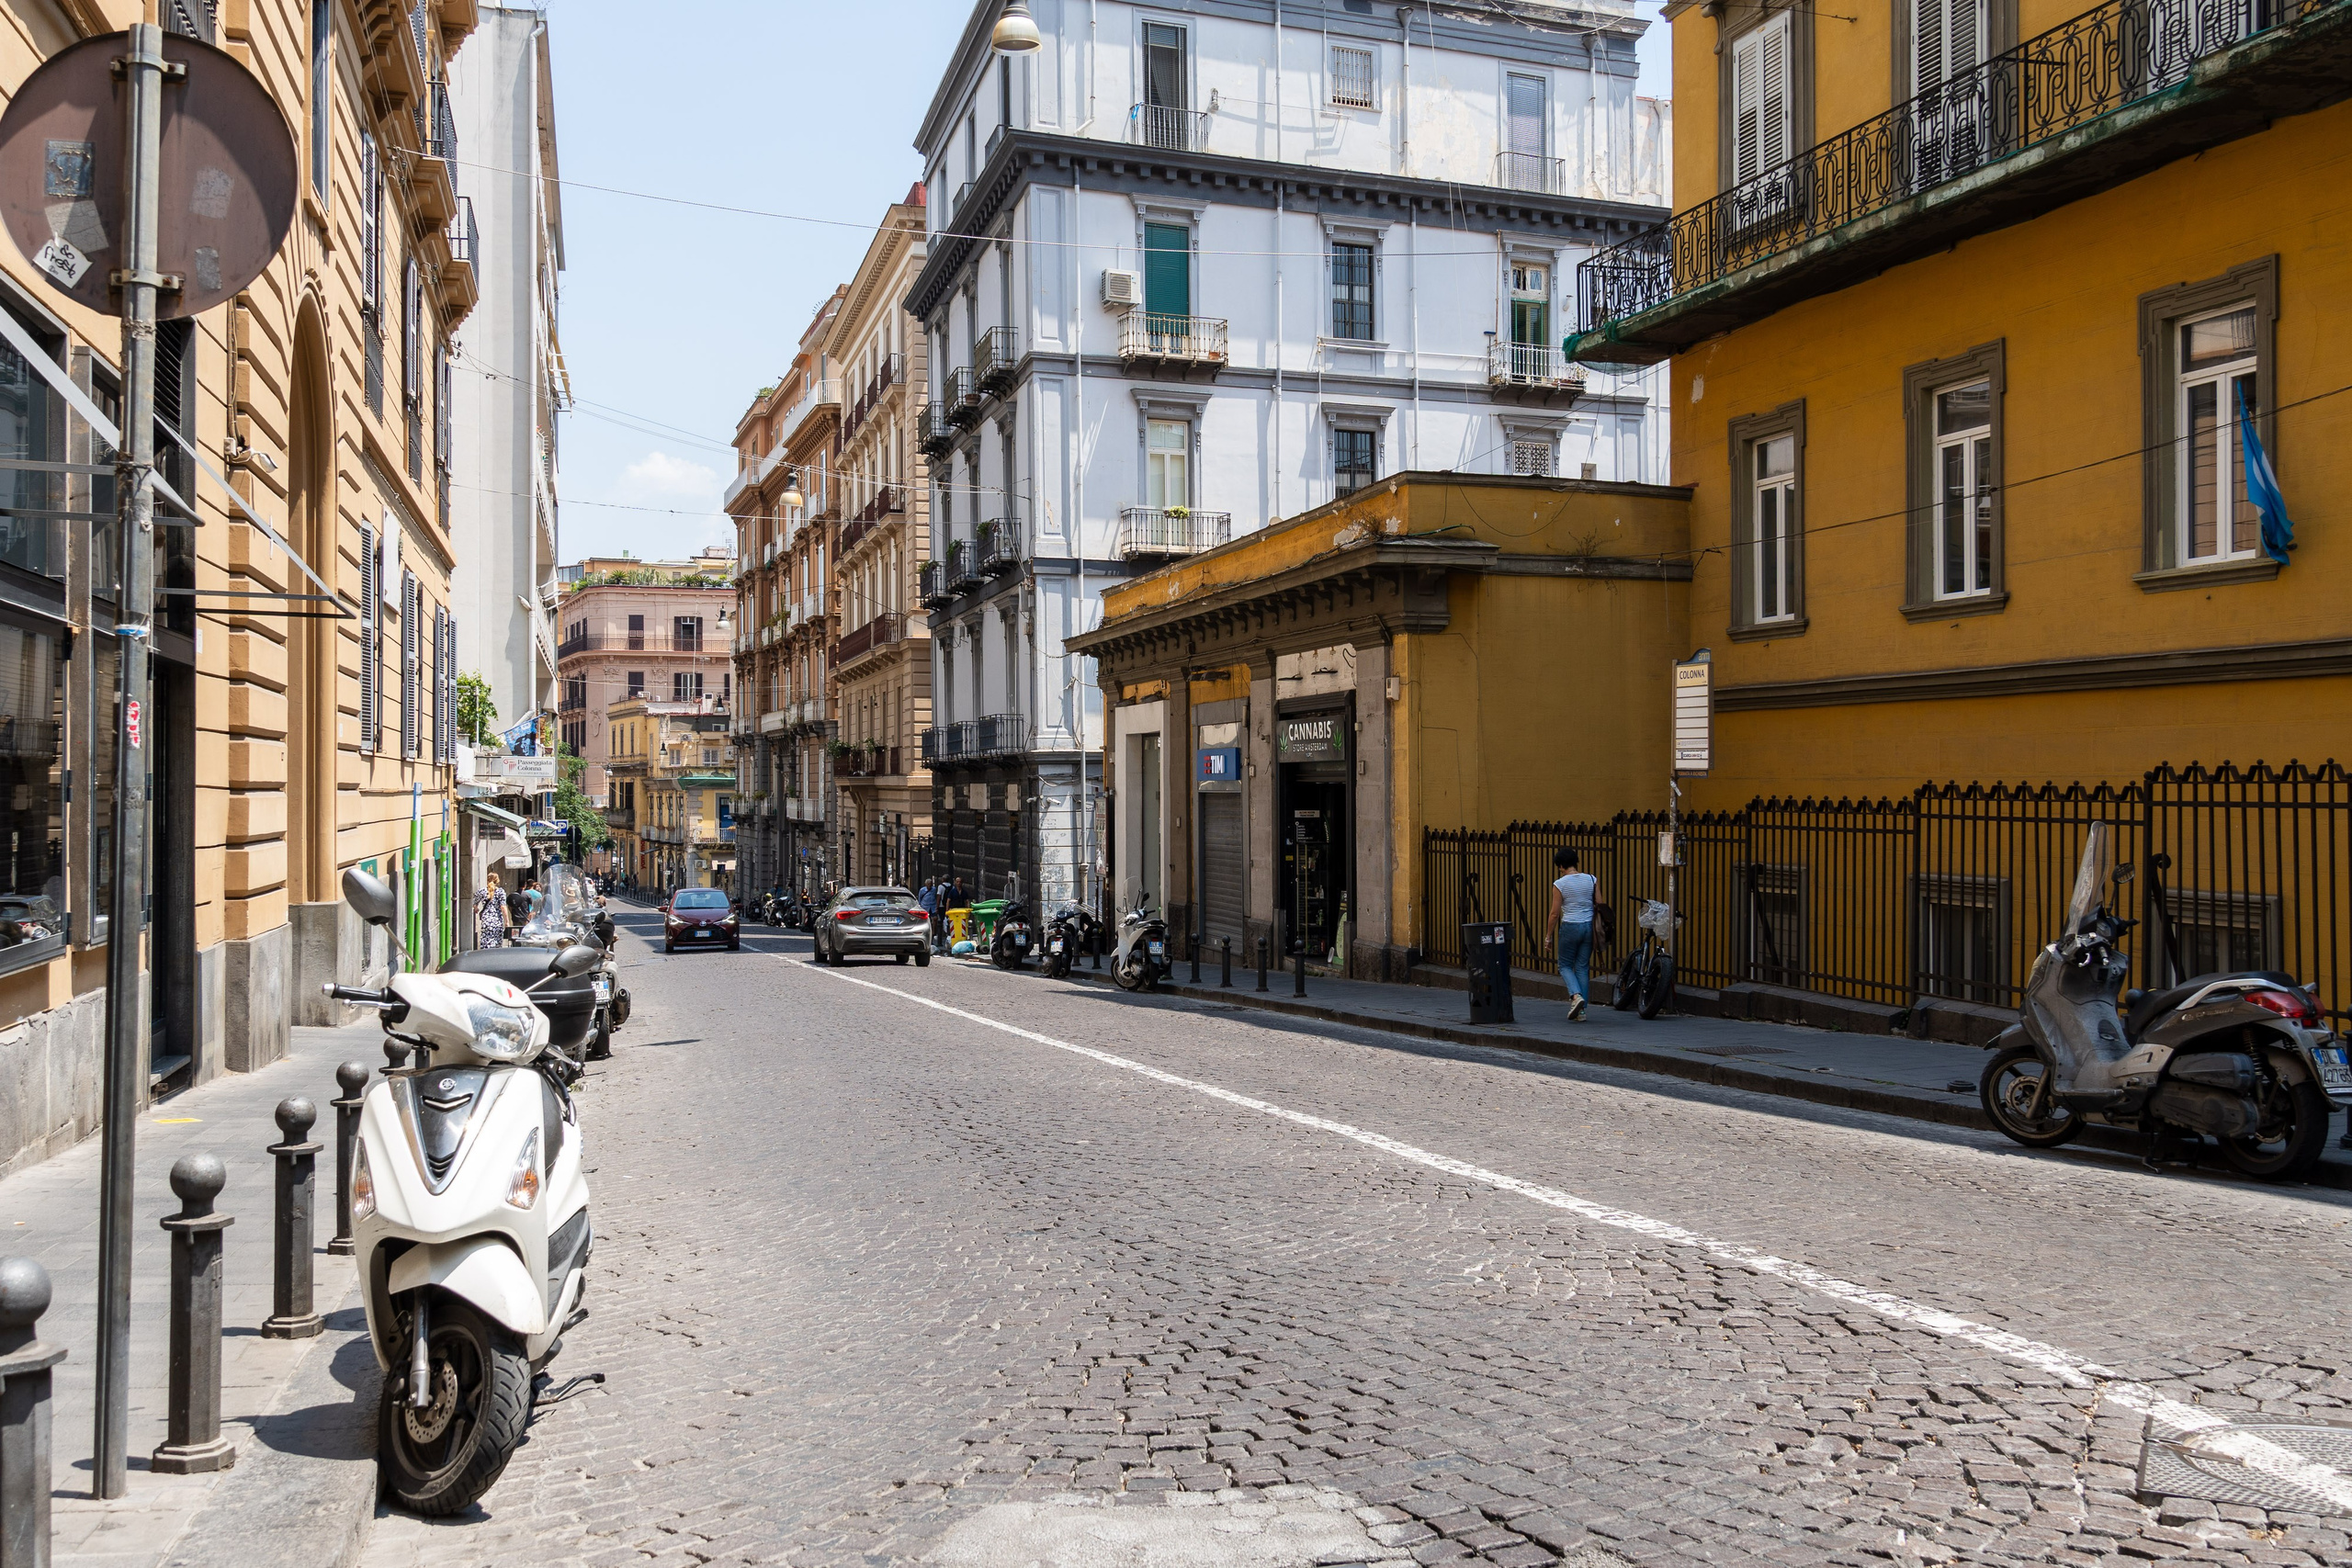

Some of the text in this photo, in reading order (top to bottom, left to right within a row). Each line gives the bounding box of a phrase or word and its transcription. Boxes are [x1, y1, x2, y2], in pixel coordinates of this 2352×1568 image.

[1679, 670, 1705, 680] COLONNA
[1288, 720, 1331, 741] CANNABIS
[517, 759, 553, 767] Passeggiata
[1210, 754, 1226, 774] TIM
[2320, 1049, 2335, 1065] DL
